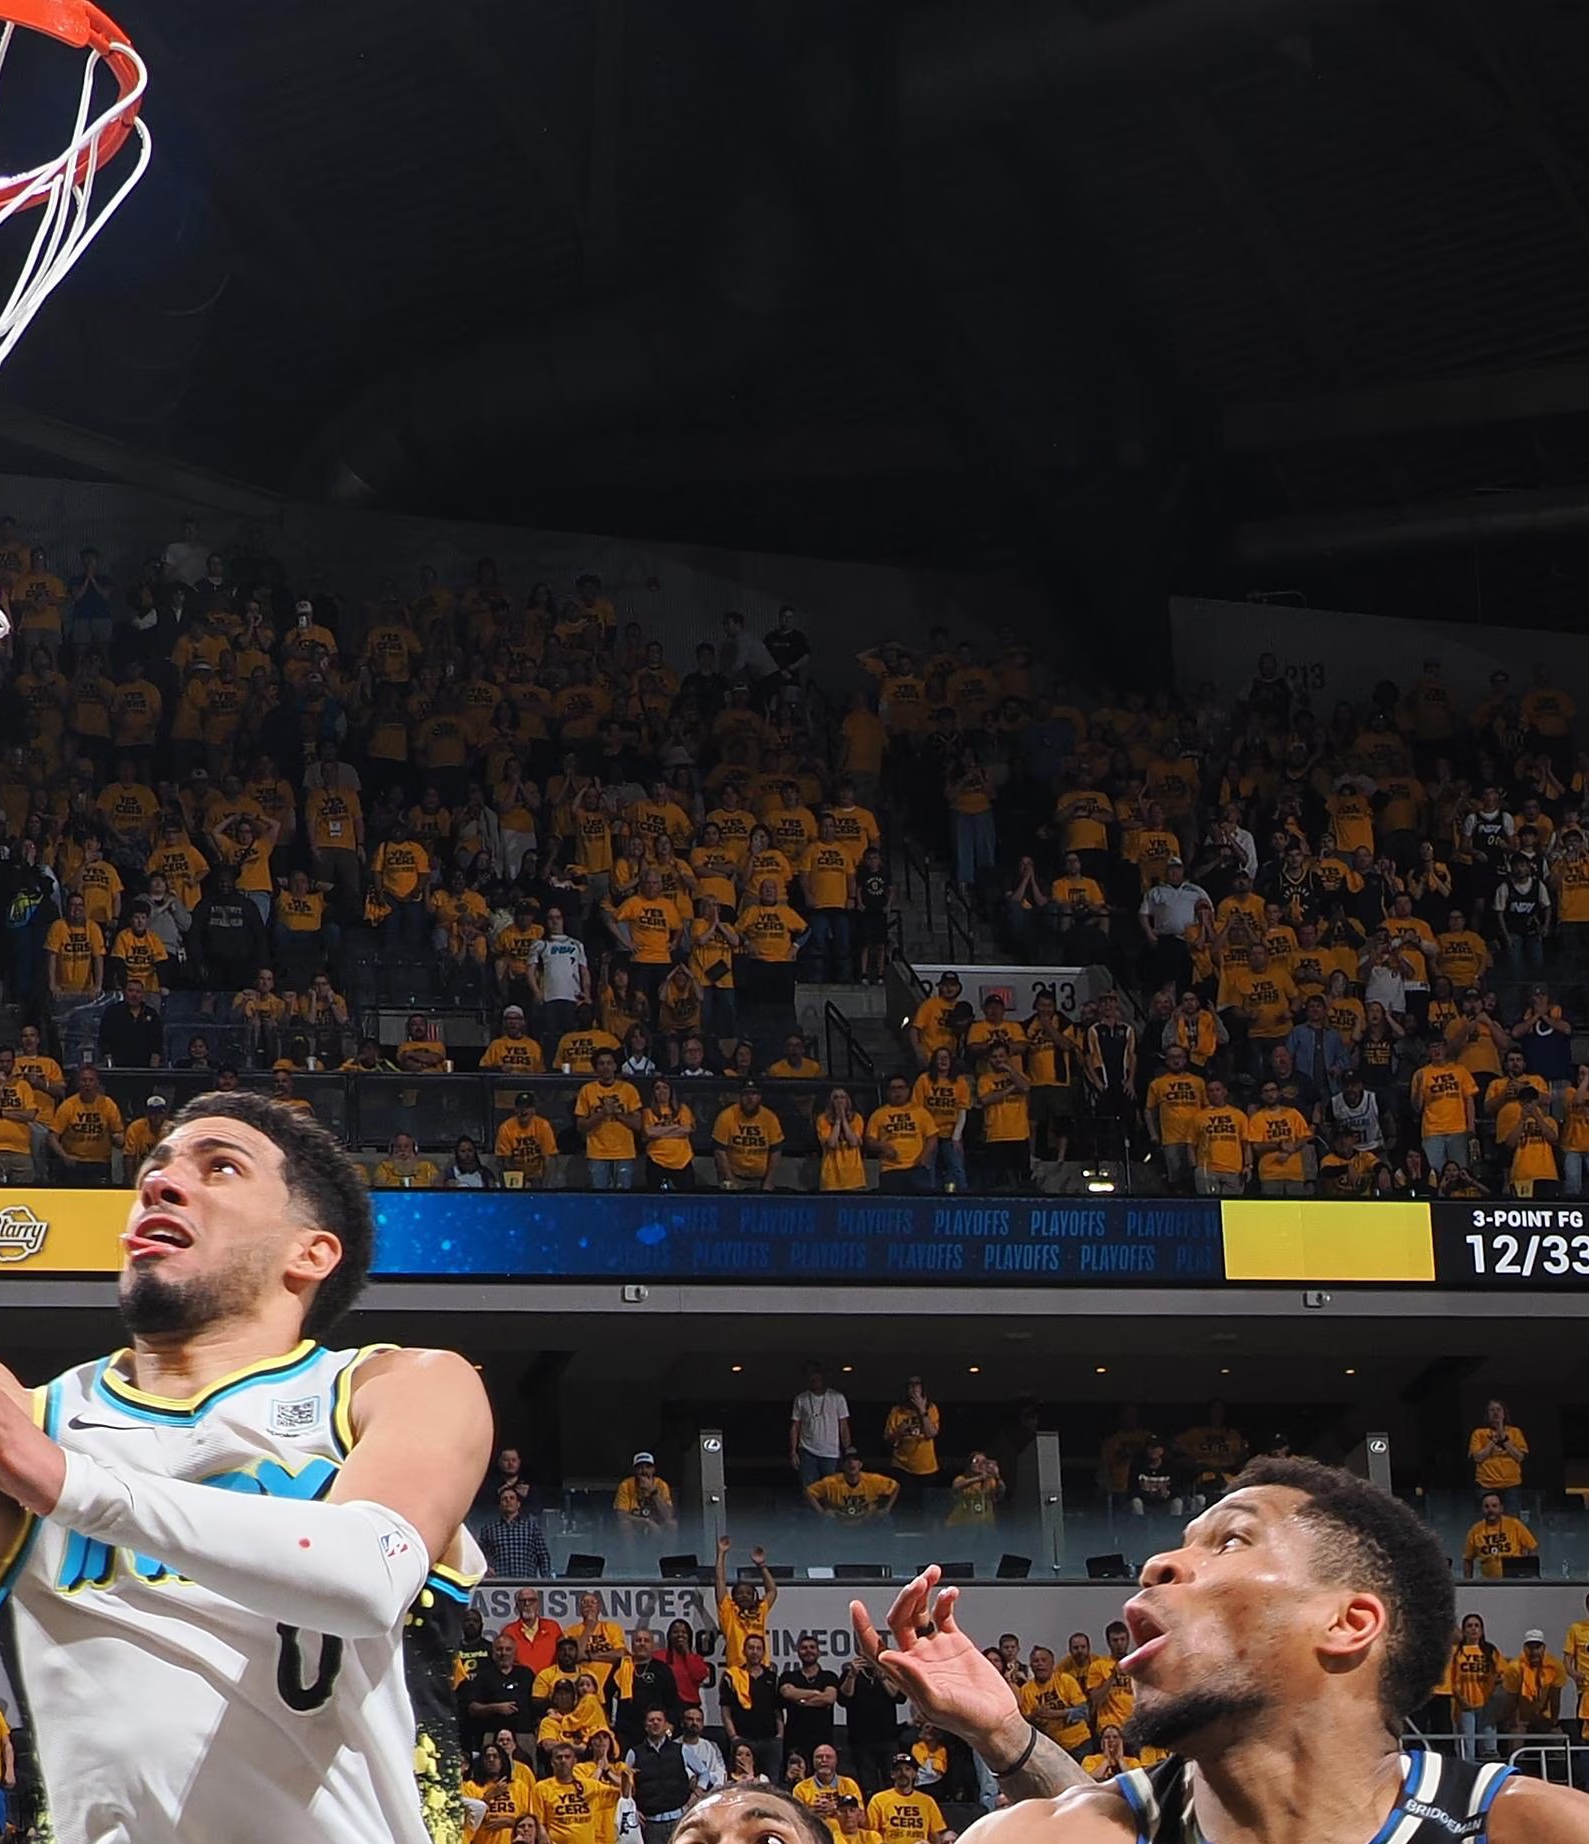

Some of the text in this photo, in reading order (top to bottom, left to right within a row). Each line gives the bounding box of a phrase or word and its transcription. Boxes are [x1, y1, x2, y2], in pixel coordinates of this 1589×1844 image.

[934, 1210, 1009, 1236] PLAYOFFS
[1030, 1210, 1105, 1237] PLAYOFFS
[1472, 1210, 1584, 1229] 3-POINT FG
[984, 1245, 1059, 1271] PLAYOFFS
[1080, 1245, 1154, 1272] PLAYOFFS
[1405, 1799, 1482, 1837] BRIDGEMAN
